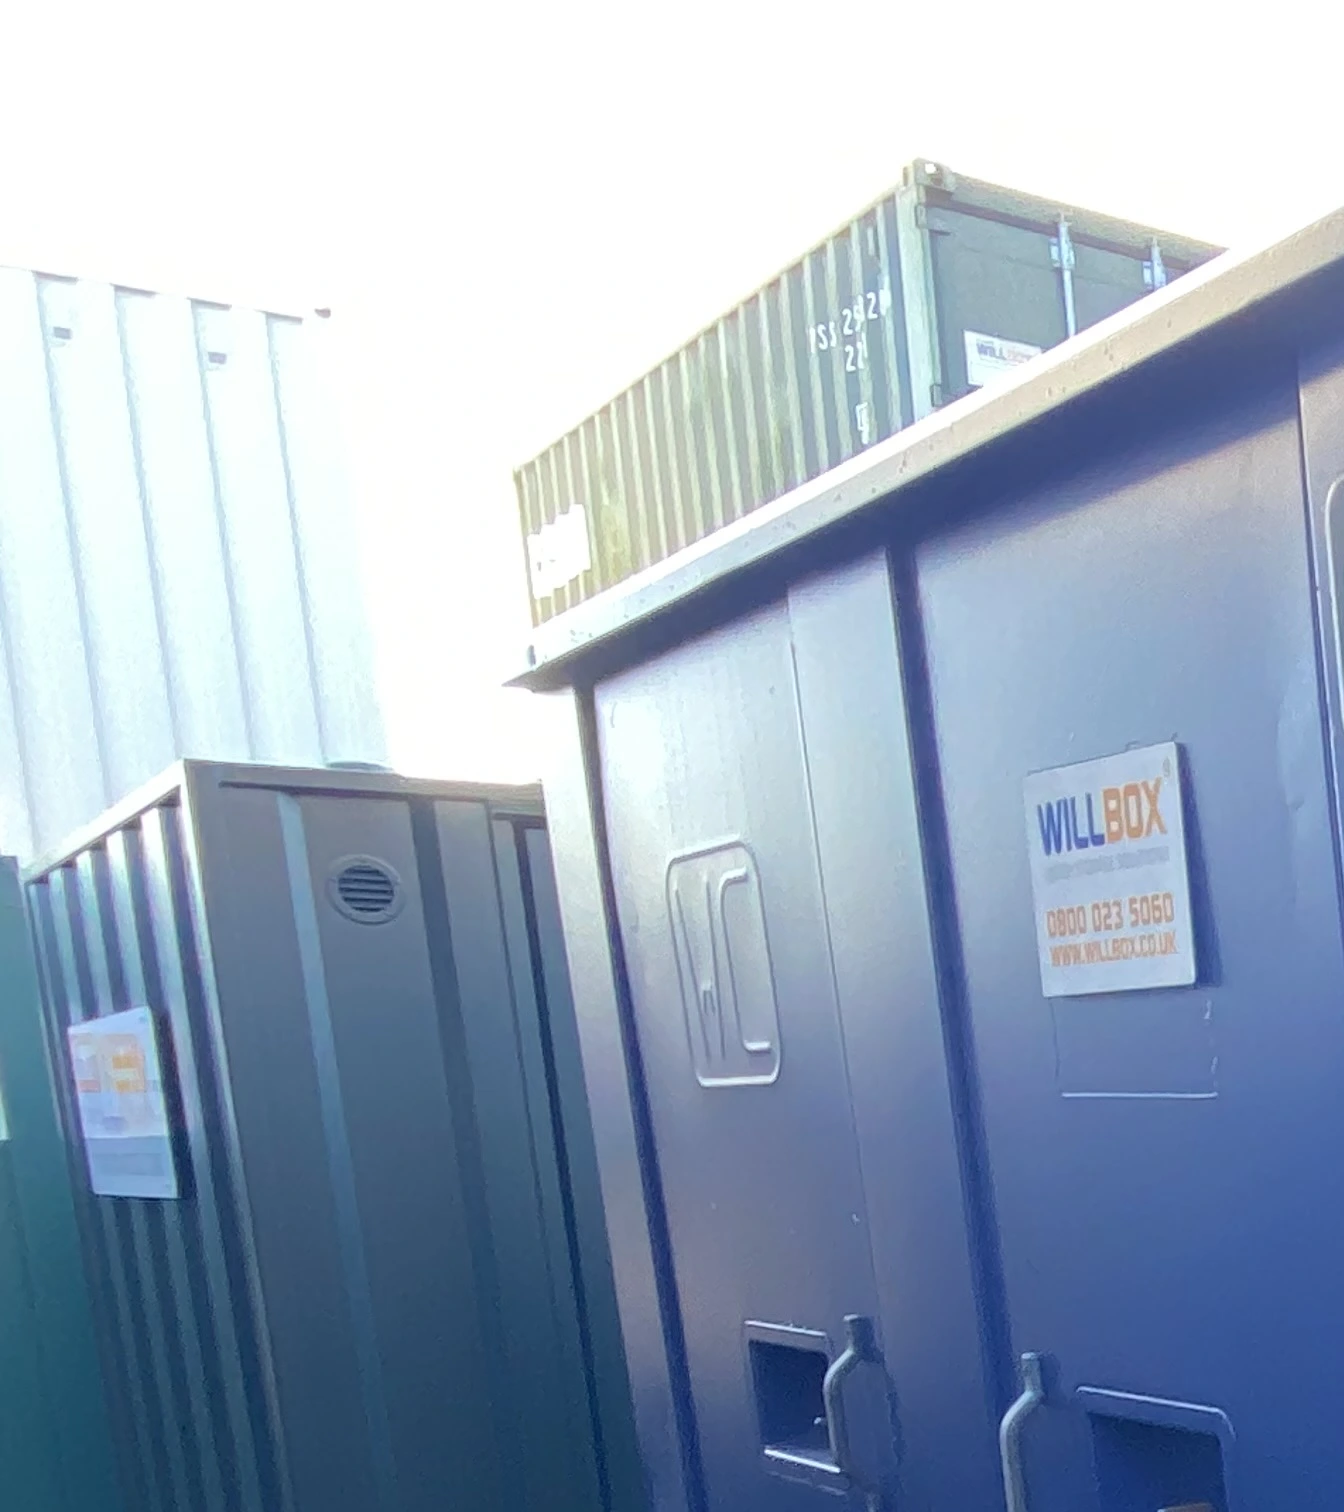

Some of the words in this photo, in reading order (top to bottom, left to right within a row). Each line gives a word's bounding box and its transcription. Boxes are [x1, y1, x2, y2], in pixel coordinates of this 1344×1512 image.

[1037, 777, 1168, 856] WILLBOX
[1046, 904, 1088, 938] 0800
[1091, 899, 1124, 931] 023
[1129, 892, 1175, 927] 5060
[1050, 930, 1180, 968] WWW.WILLBOX.CO.UK
